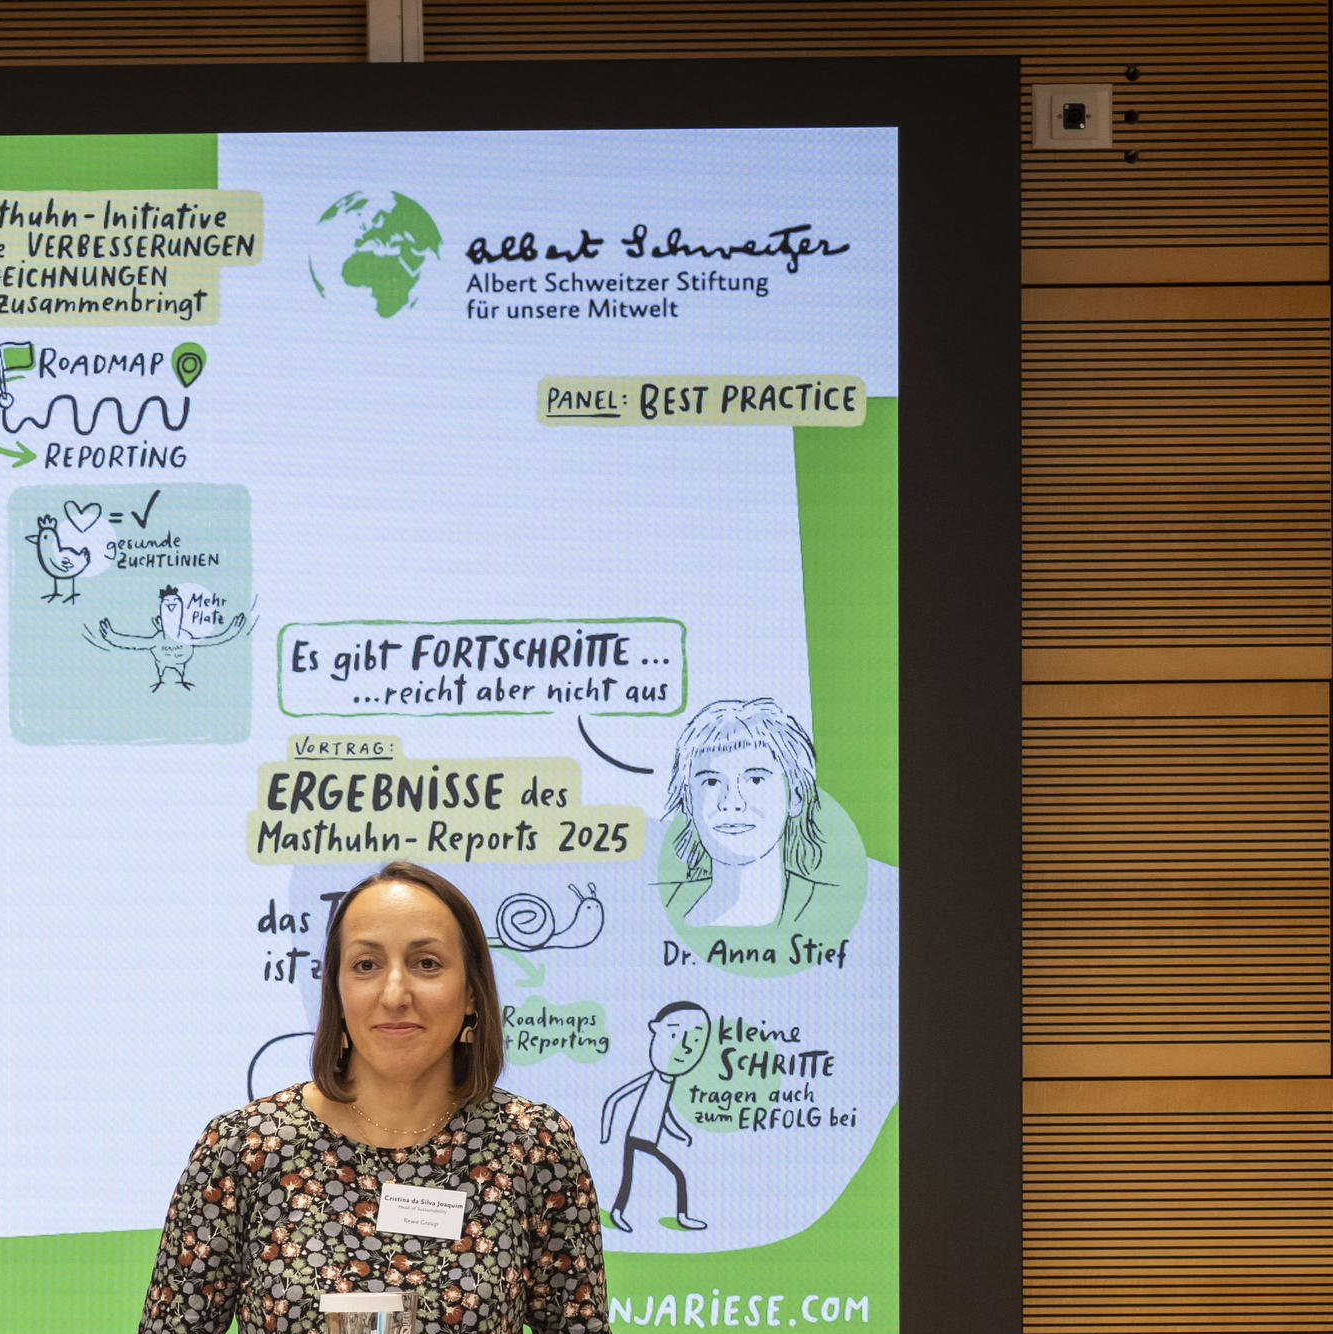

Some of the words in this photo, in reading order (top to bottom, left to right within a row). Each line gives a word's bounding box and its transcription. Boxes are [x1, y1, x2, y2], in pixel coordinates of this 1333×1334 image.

[28, 231, 255, 260] VERBESSERUNGEN
[465, 272, 538, 294] Albert
[544, 271, 670, 293] Schweitzer
[676, 269, 770, 298] Stiftung
[466, 298, 500, 320] für
[506, 304, 581, 320] unsere
[588, 297, 679, 319] Mitwelt
[38, 347, 165, 379] ROADMAP
[547, 386, 628, 414] PANEL:
[639, 383, 710, 421] BEST
[721, 380, 857, 415] PRACTICE
[44, 439, 187, 470] REPORTING
[104, 530, 181, 559] gesunde
[116, 551, 220, 570] ZUCHTLINIEN
[186, 592, 228, 610] Mehr
[191, 609, 225, 626] Platz
[291, 639, 319, 673] Es
[329, 639, 403, 682] gibt
[476, 676, 536, 702] aber
[547, 676, 619, 704] nicht
[625, 683, 669, 704] aus
[295, 735, 394, 756] VORTRAG:
[267, 764, 505, 815] ERGEBNISSE
[520, 775, 568, 809] des
[558, 820, 630, 853] 2025
[257, 898, 311, 935] das
[263, 946, 311, 985] ist
[663, 940, 696, 967] Dr.
[706, 938, 776, 966] Anna
[788, 933, 850, 970] Stief
[503, 1005, 596, 1033] Roadmaps
[718, 1014, 801, 1046] kleine
[517, 1030, 610, 1055] Reporting
[718, 1046, 835, 1082] SCHRITTE
[688, 1084, 758, 1112] tragen
[768, 1081, 815, 1104] auch
[694, 1111, 733, 1124] zum
[738, 1106, 822, 1133] ERFOLG
[829, 1106, 857, 1128] bei
[420, 1199, 436, 1207] Silva
[609, 1288, 870, 1329] NJARIESE.COM
